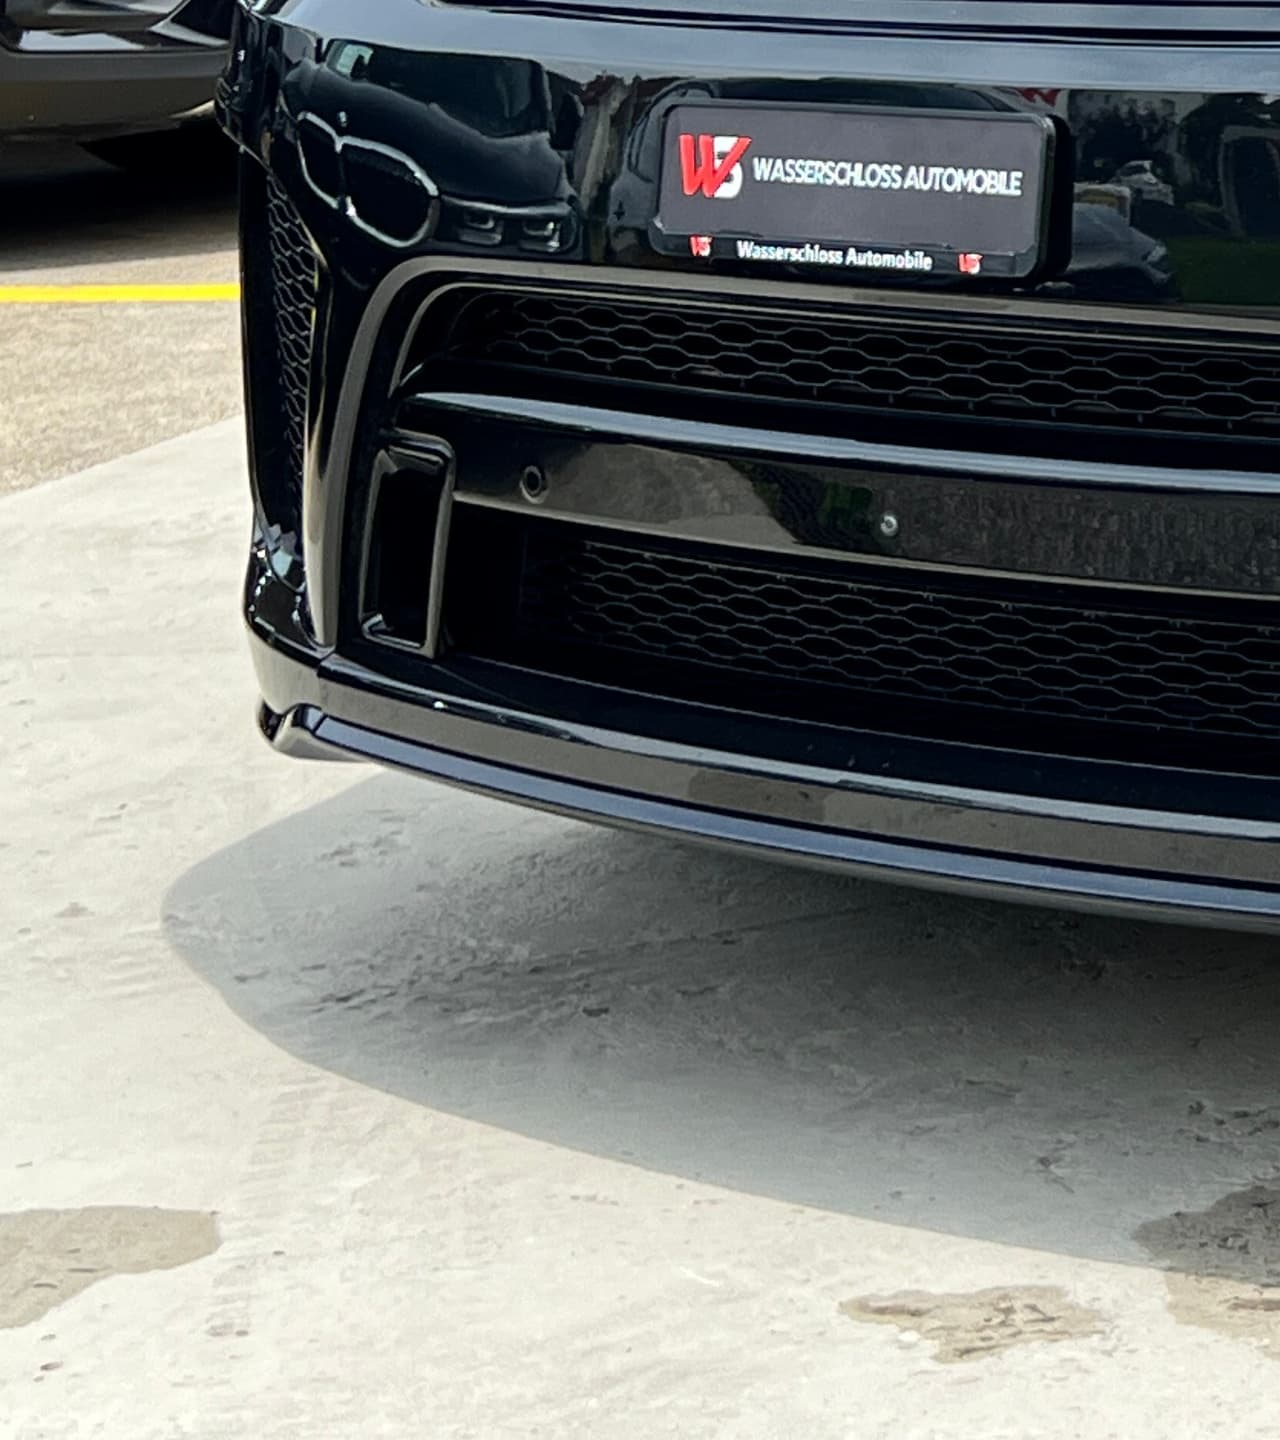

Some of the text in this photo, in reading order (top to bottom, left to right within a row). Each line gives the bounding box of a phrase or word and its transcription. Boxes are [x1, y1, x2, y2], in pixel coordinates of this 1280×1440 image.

[753, 156, 902, 190] WASSERSCHLOSS
[904, 165, 1024, 197] AUTOMOBILE
[736, 240, 933, 272] Wasserschloss Automobile
